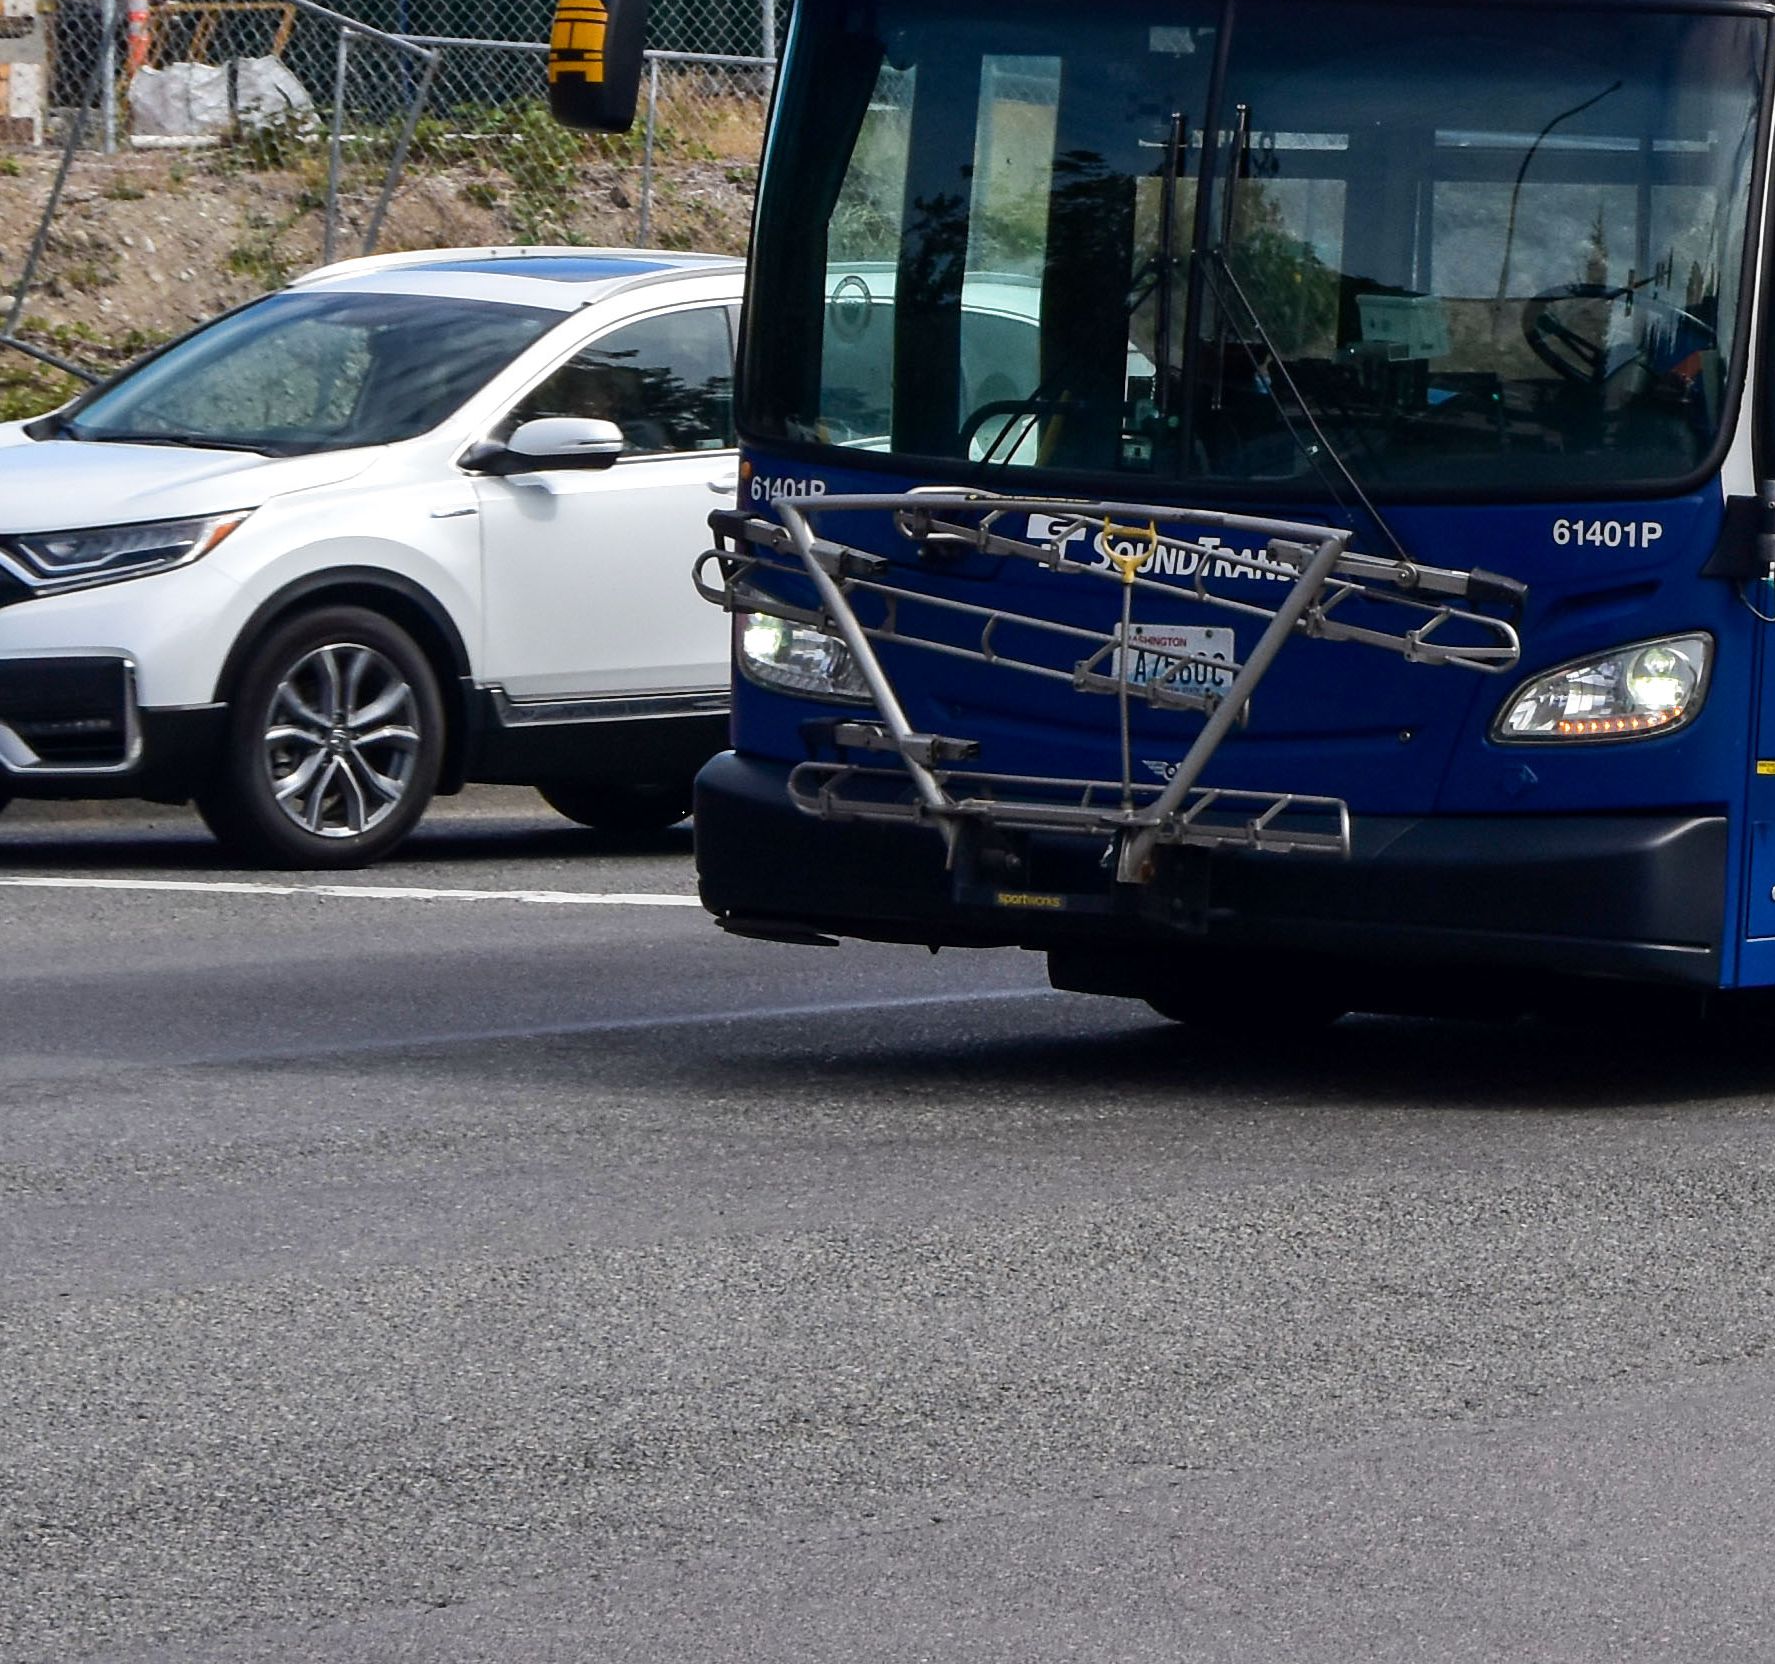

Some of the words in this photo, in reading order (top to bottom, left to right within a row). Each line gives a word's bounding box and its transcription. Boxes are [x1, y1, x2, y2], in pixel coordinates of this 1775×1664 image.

[750, 475, 826, 502] 61401P
[1552, 519, 1664, 549] 61401P
[1129, 635, 1187, 648] ASHINGTON
